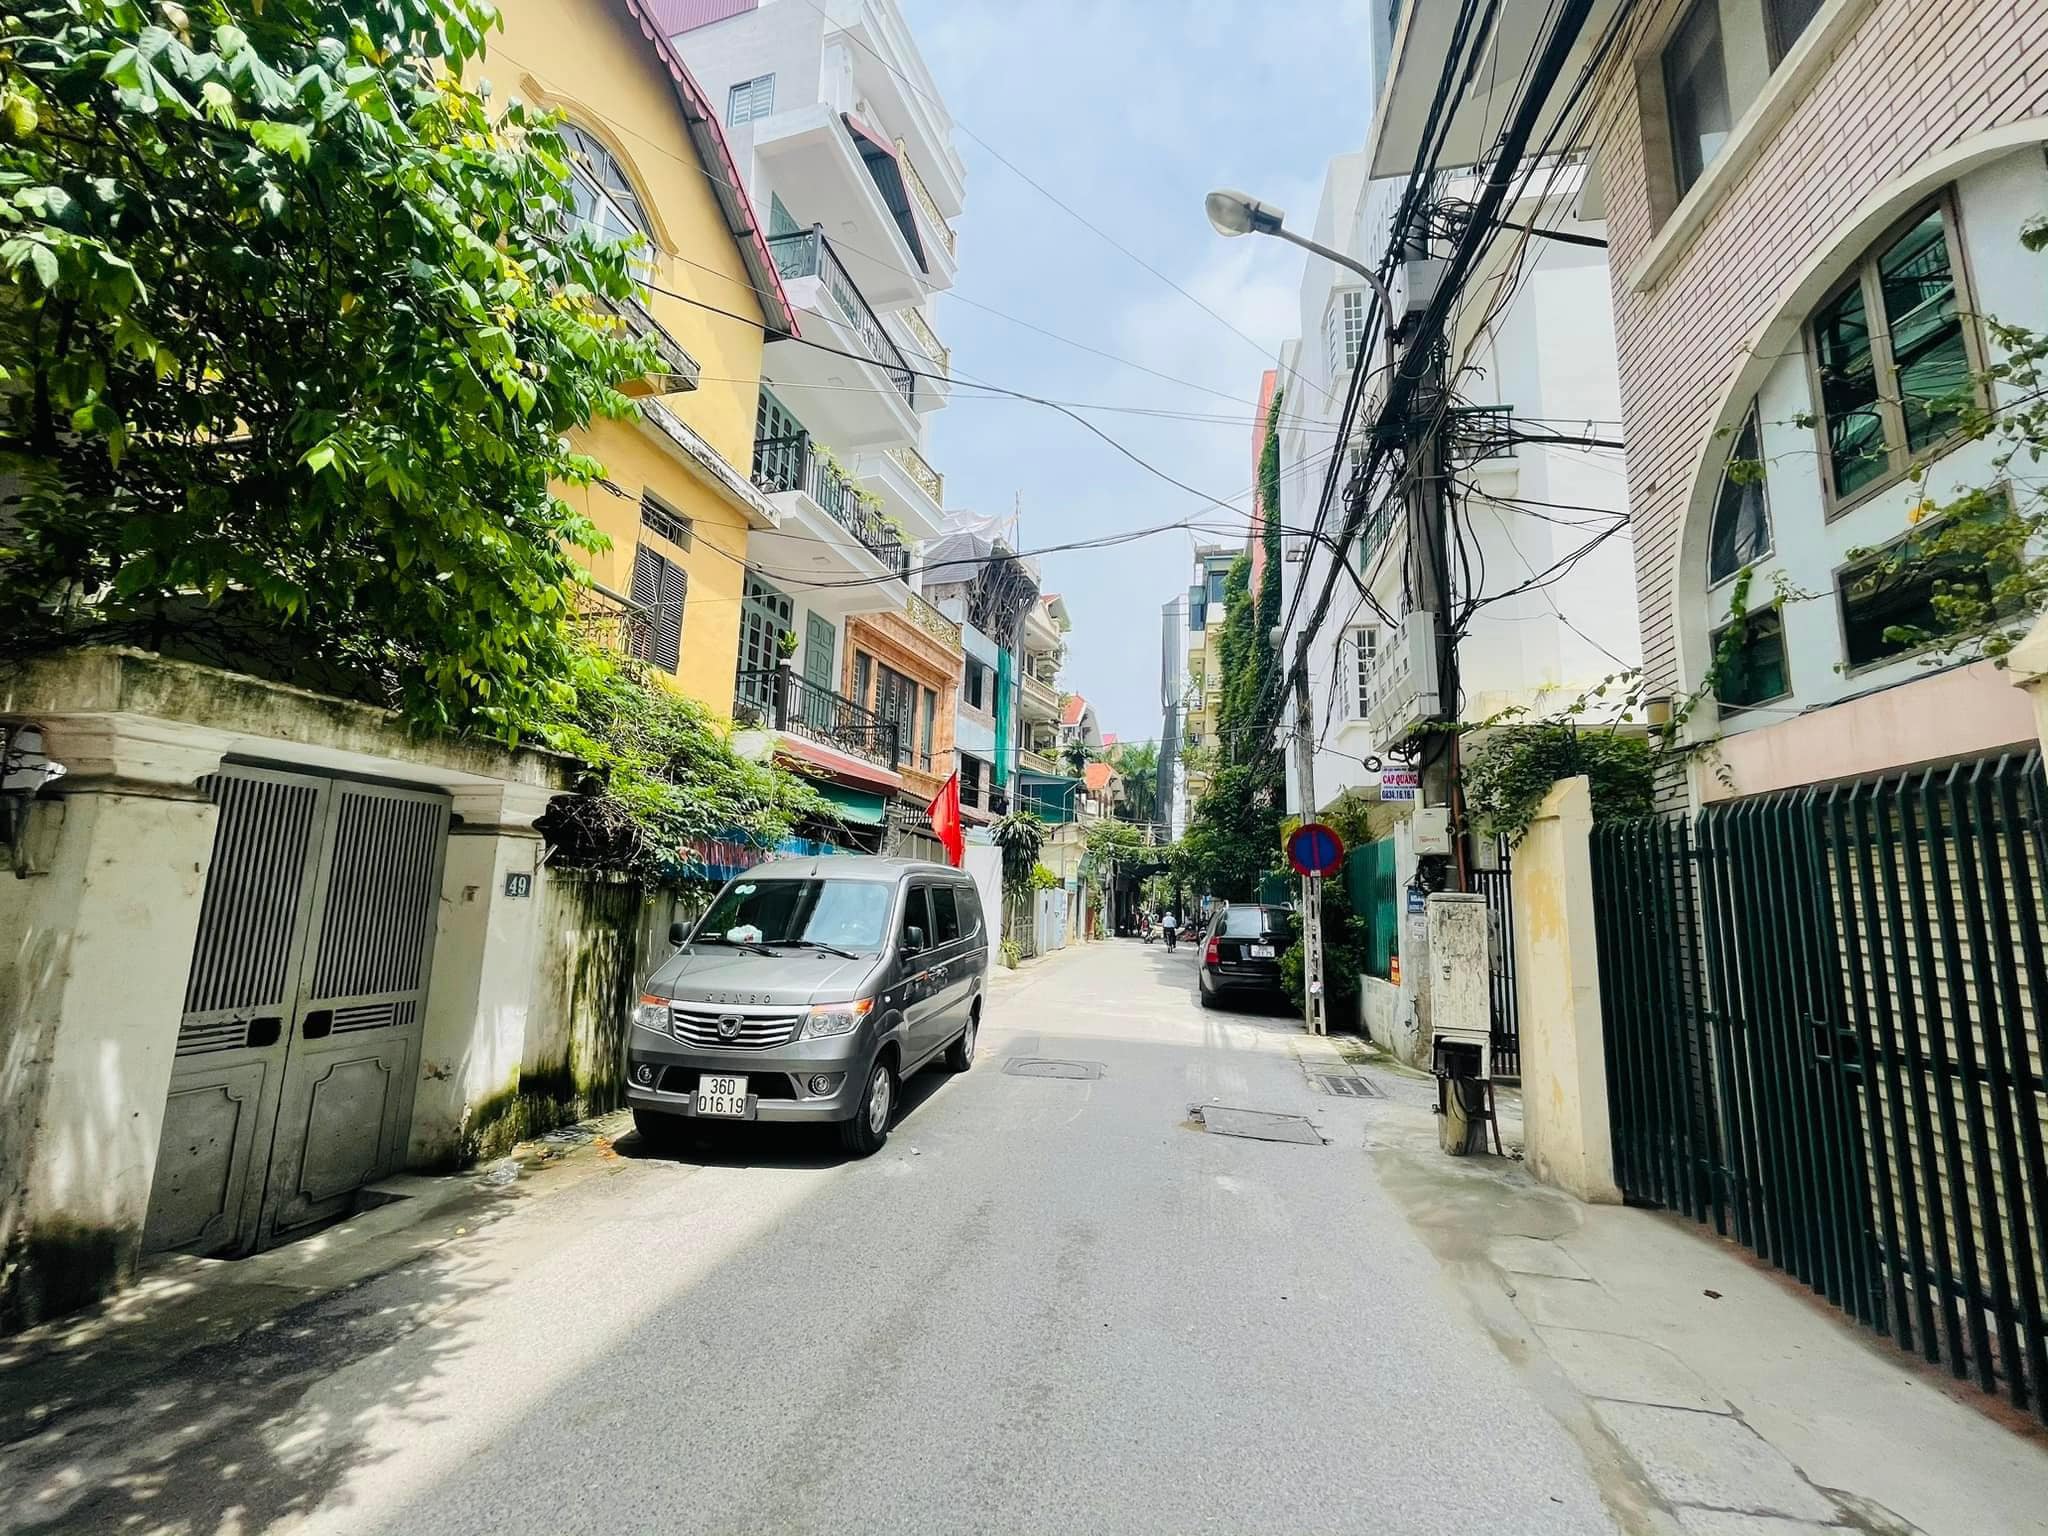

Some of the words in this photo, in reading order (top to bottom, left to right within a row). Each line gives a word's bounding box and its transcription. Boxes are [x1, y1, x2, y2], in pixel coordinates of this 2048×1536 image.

[508, 875, 527, 894] 49
[710, 1078, 736, 1096] 36D
[698, 1095, 744, 1114] 016.19
